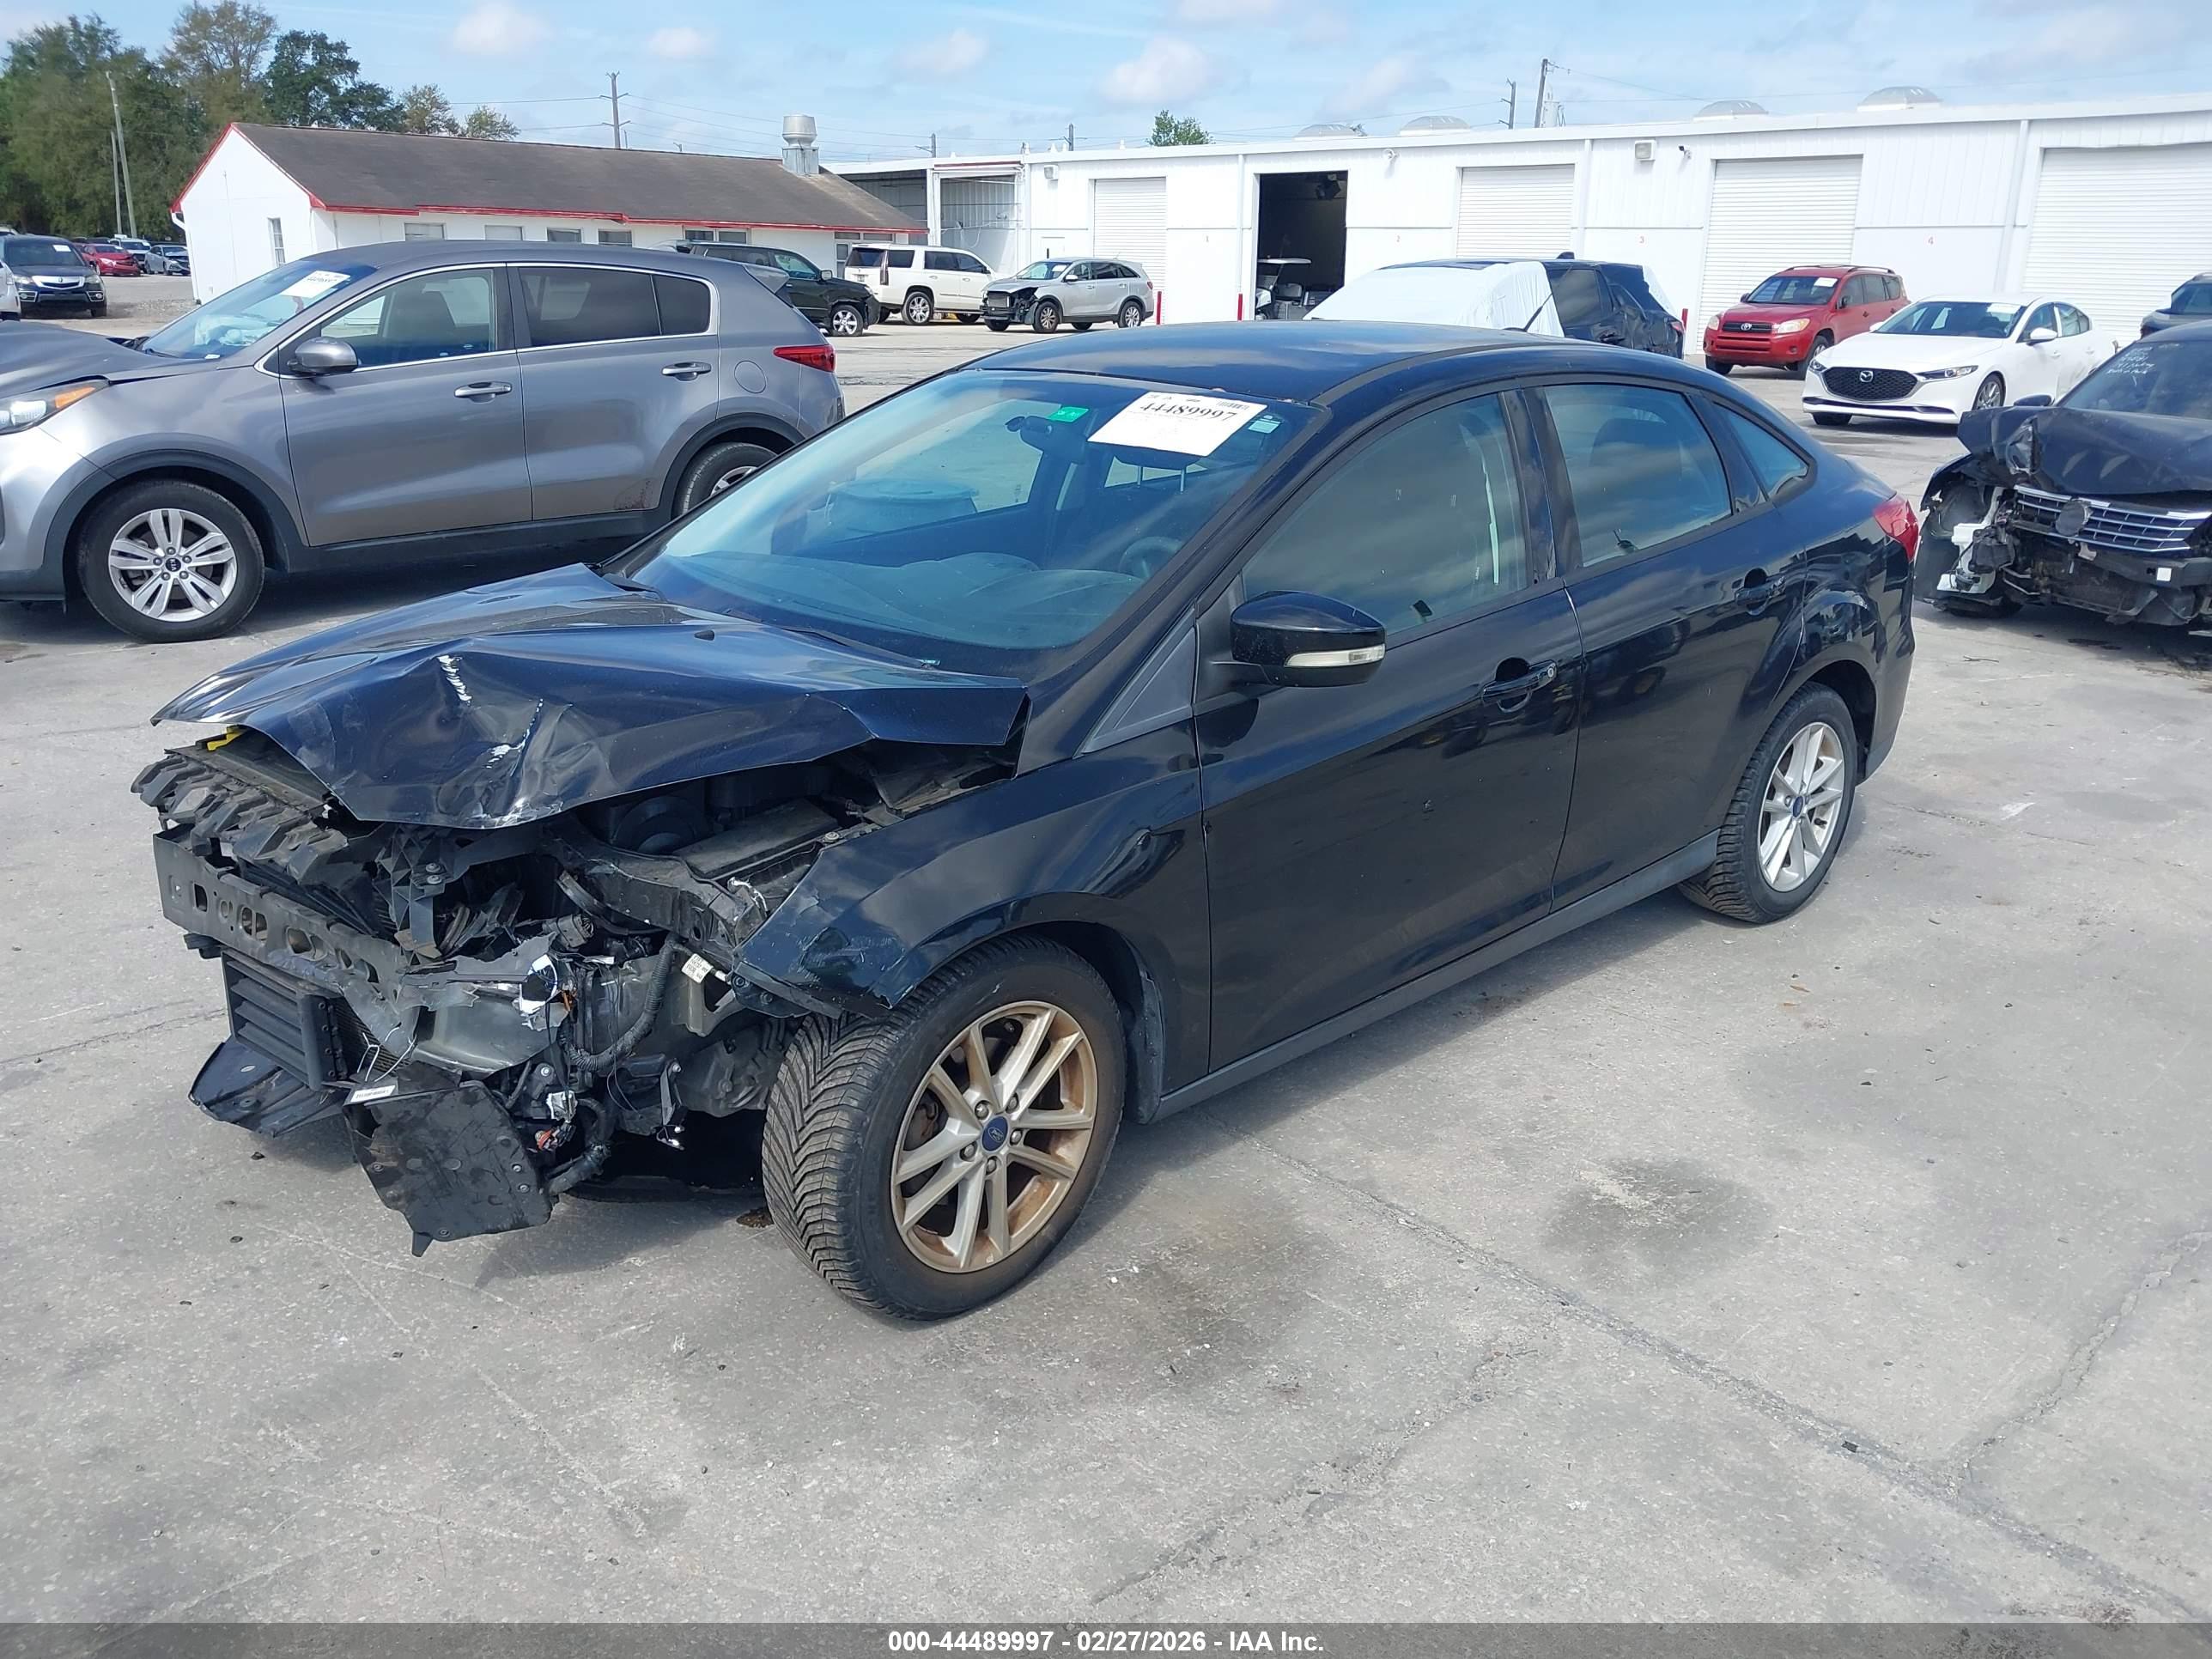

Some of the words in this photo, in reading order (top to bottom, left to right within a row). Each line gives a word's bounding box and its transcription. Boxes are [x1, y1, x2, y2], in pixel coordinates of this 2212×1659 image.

[1638, 235, 1645, 244] 3
[1928, 236, 1934, 245] 4
[1140, 403, 1237, 422] 44489997
